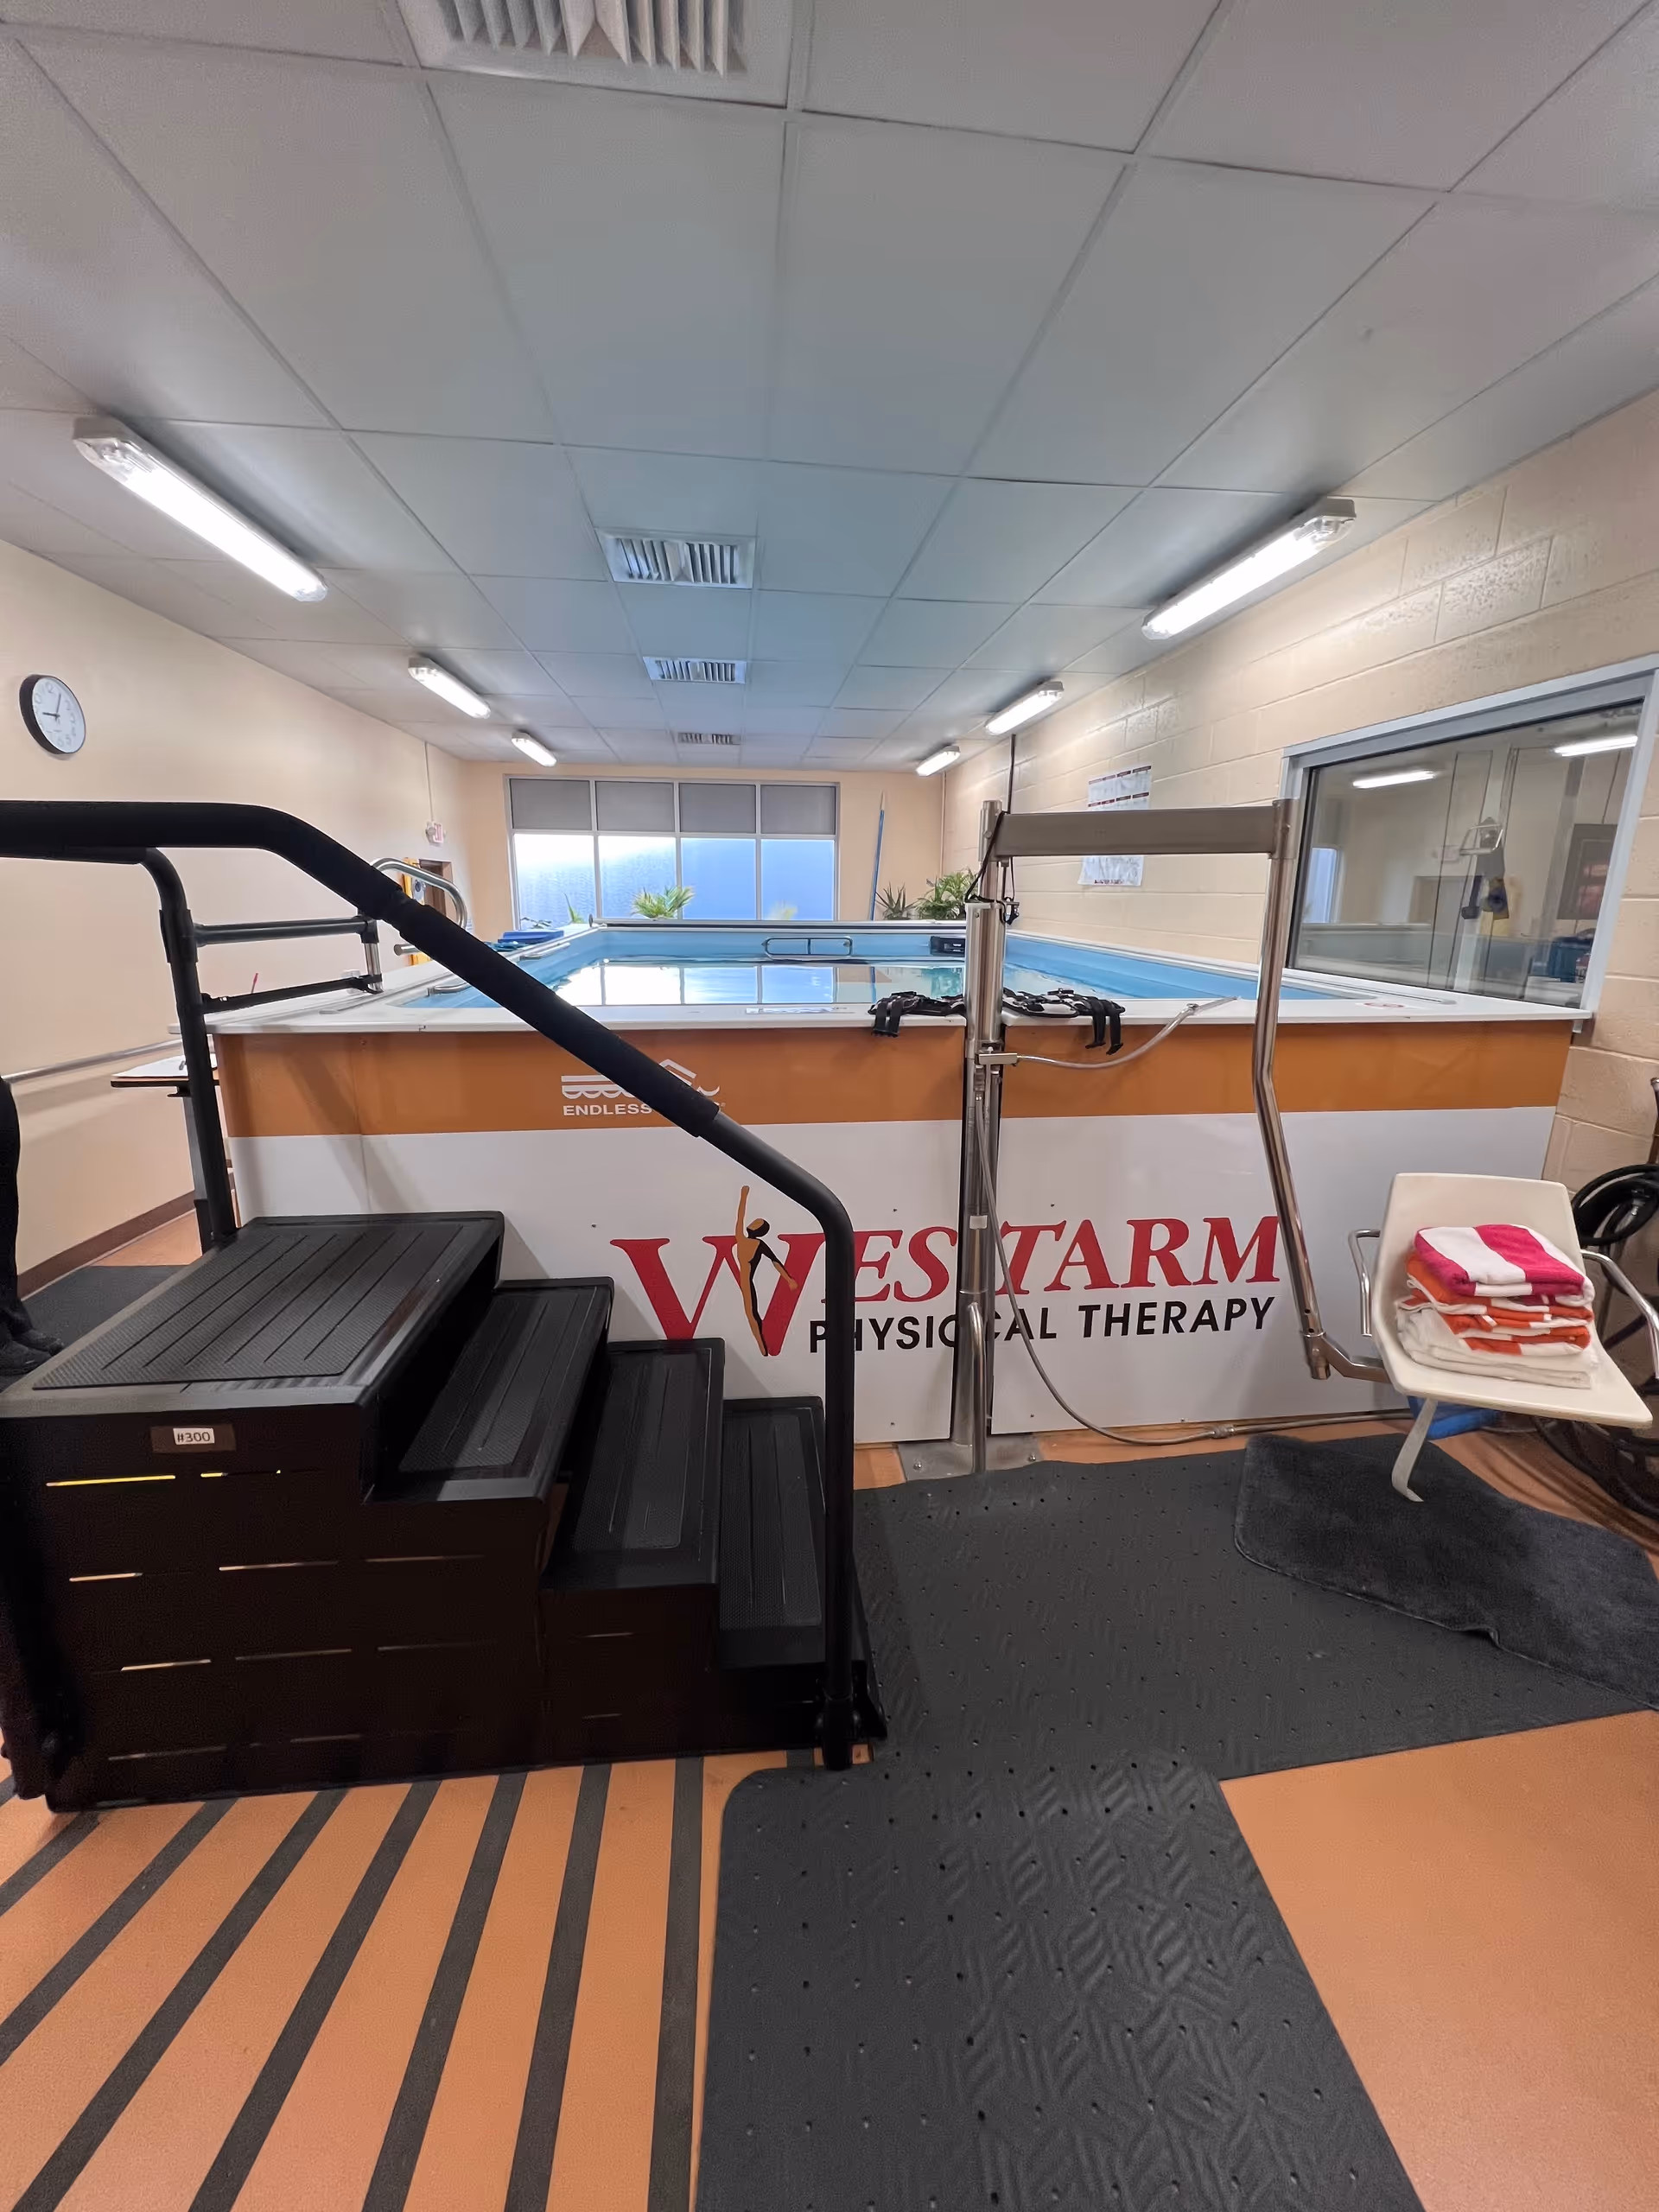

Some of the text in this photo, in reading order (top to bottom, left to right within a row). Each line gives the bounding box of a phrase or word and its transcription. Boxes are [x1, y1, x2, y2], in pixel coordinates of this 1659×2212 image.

[563, 1103, 653, 1116] ENDLESS
[610, 1216, 1280, 1356] WESTARM
[1077, 1296, 1274, 1338] THERAPY
